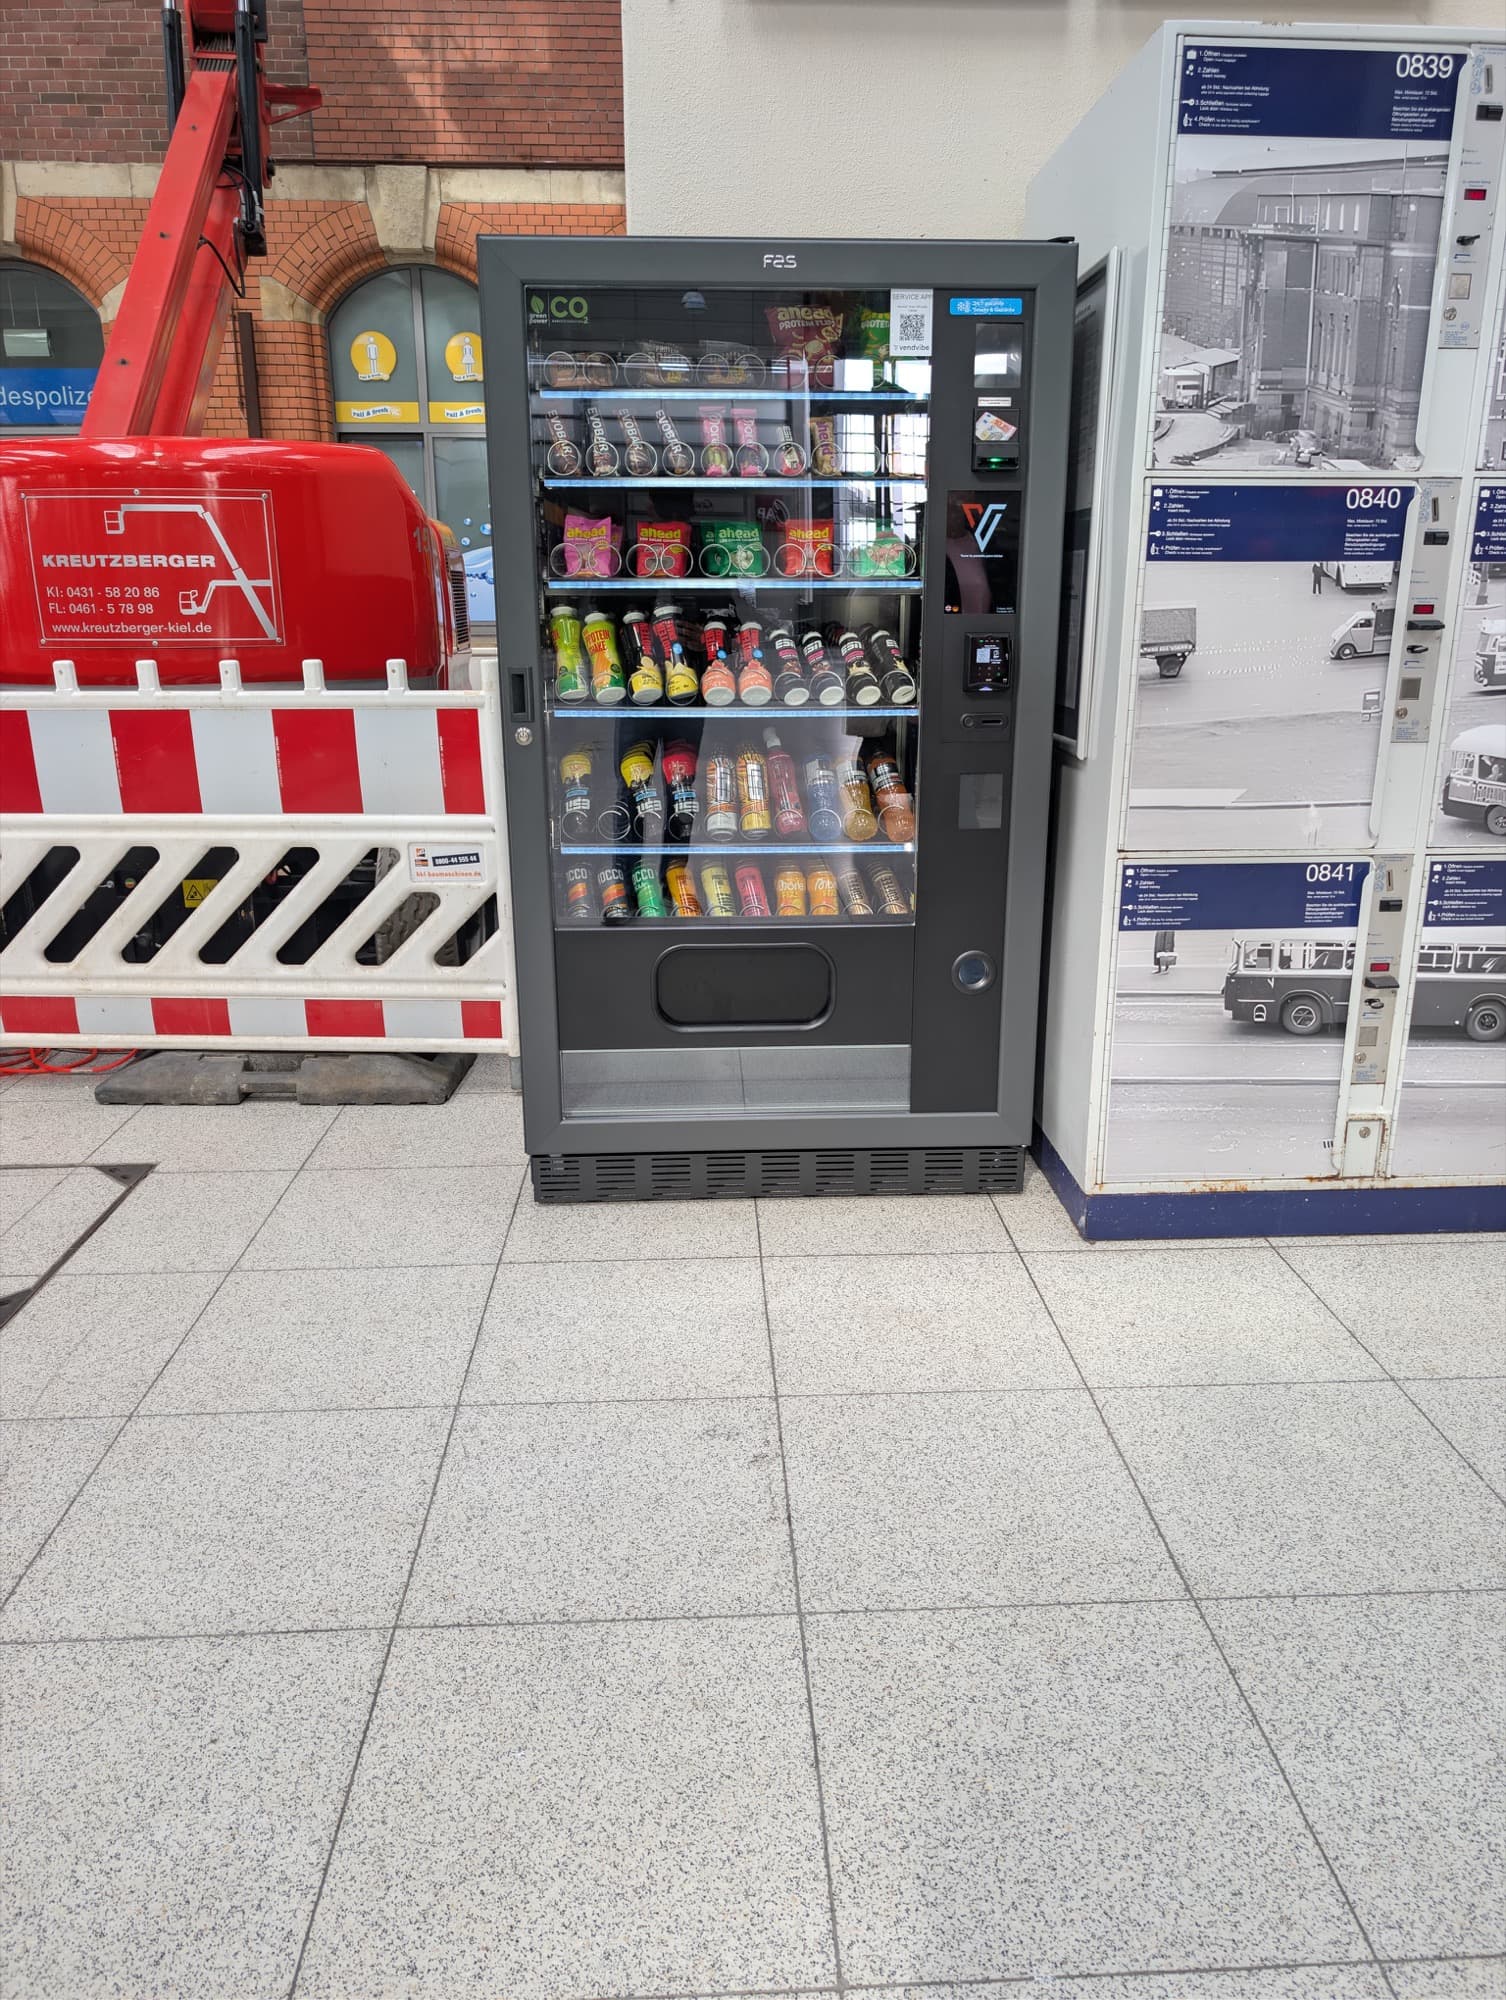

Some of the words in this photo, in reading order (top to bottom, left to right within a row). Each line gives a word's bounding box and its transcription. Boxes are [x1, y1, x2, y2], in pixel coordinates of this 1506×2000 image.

[1395, 54, 1454, 79] 0839
[1346, 487, 1401, 509] 0840
[566, 526, 606, 538] ahead
[639, 527, 681, 539] ahead
[718, 528, 760, 539] ahead
[788, 527, 830, 539] ahead
[42, 554, 217, 568] KREUTZBERGER
[66, 586, 94, 598] 0431
[105, 587, 121, 598] 58
[124, 587, 140, 598] 20
[143, 586, 160, 598] 86
[48, 603, 66, 614] FL:
[69, 603, 96, 614] 0461
[107, 603, 115, 614] 5
[118, 603, 135, 614] 78
[137, 603, 154, 614] 98
[52, 622, 213, 635] www.kreutzberger-kiel.de
[1306, 864, 1354, 882] 0841
